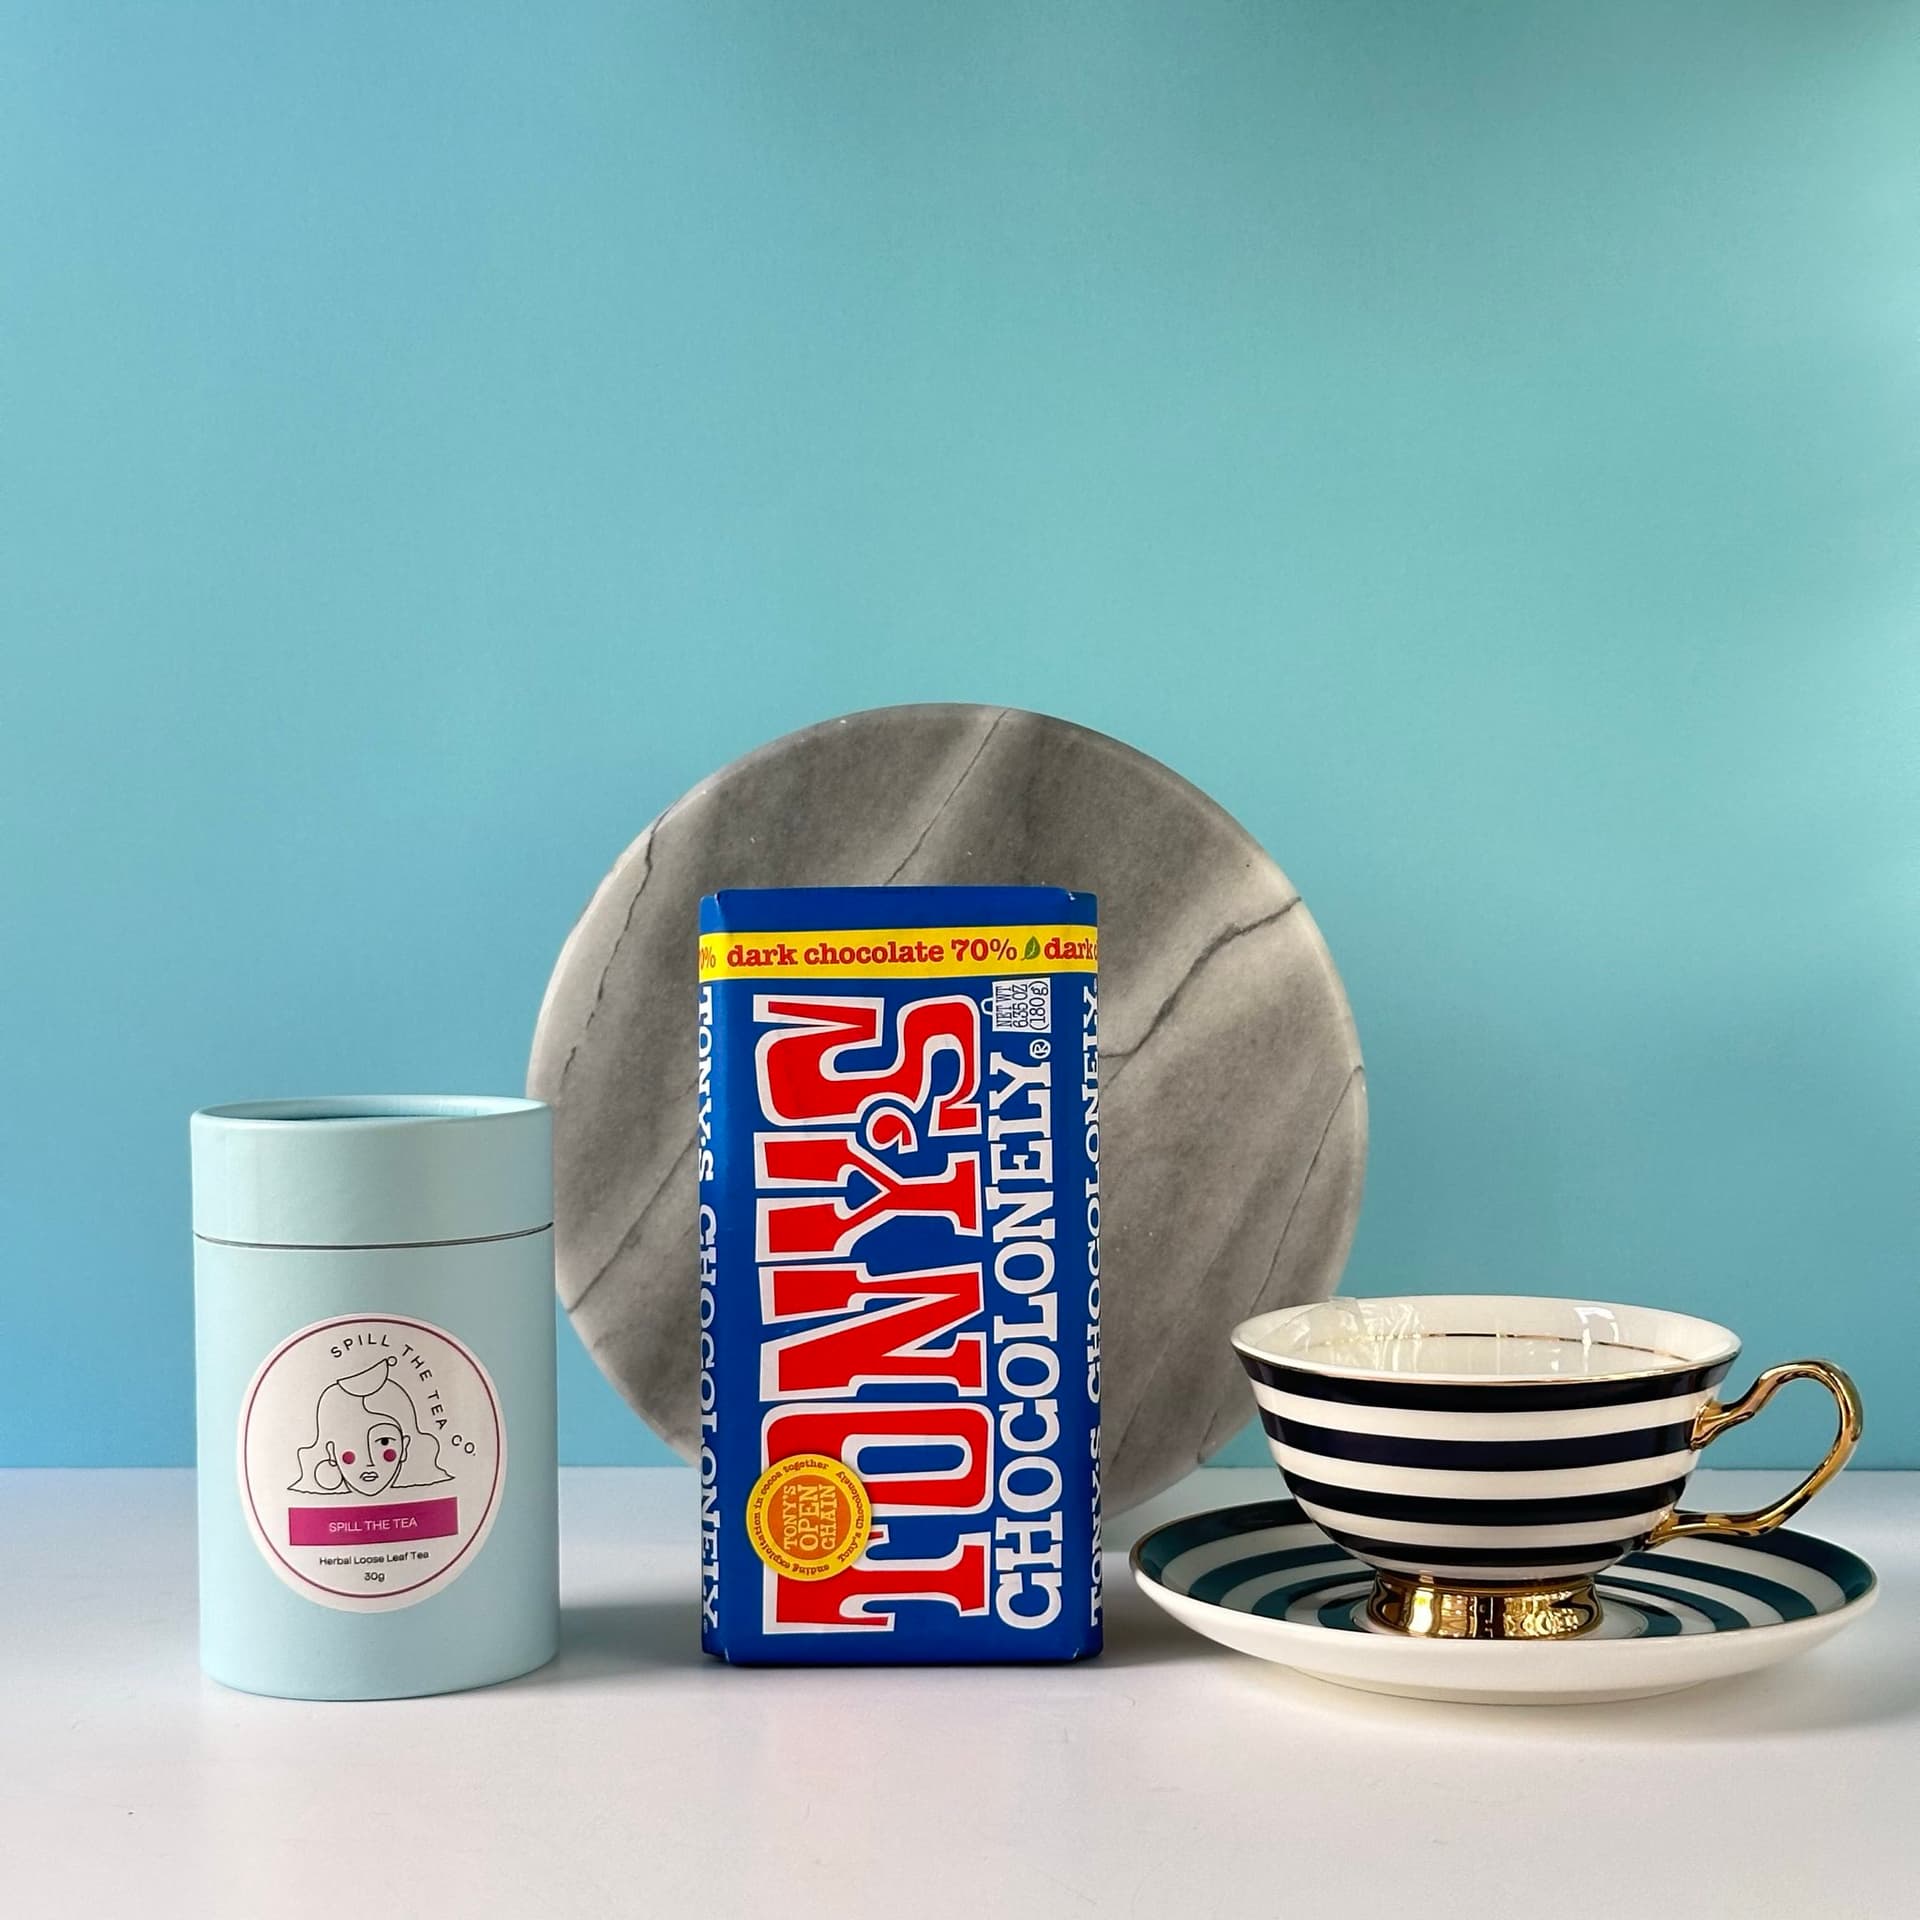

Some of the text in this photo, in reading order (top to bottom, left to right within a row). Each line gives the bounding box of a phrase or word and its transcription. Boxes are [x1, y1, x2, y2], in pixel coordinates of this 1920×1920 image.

[727, 944, 798, 967] dark
[804, 941, 945, 965] chocolate
[951, 938, 1017, 961] 70%
[995, 985, 1012, 1028] NET WT
[1012, 984, 1028, 1001] OZ
[753, 994, 994, 1635] TONY'S
[330, 1333, 390, 1358] SPILL
[402, 1344, 432, 1382] THE
[428, 1390, 448, 1430] TEA
[329, 1517, 418, 1533] SPILL THE TEA
[753, 1459, 830, 1576] ending exploitation in cocoa together
[782, 1485, 798, 1550] TONY'S
[797, 1484, 819, 1551] OPEN
[819, 1484, 837, 1550] CHAIN
[835, 1471, 865, 1563] Tony's Chocolonely
[319, 1551, 430, 1566] Herbal Loose Leaf Tea
[364, 1571, 385, 1582] 30g
